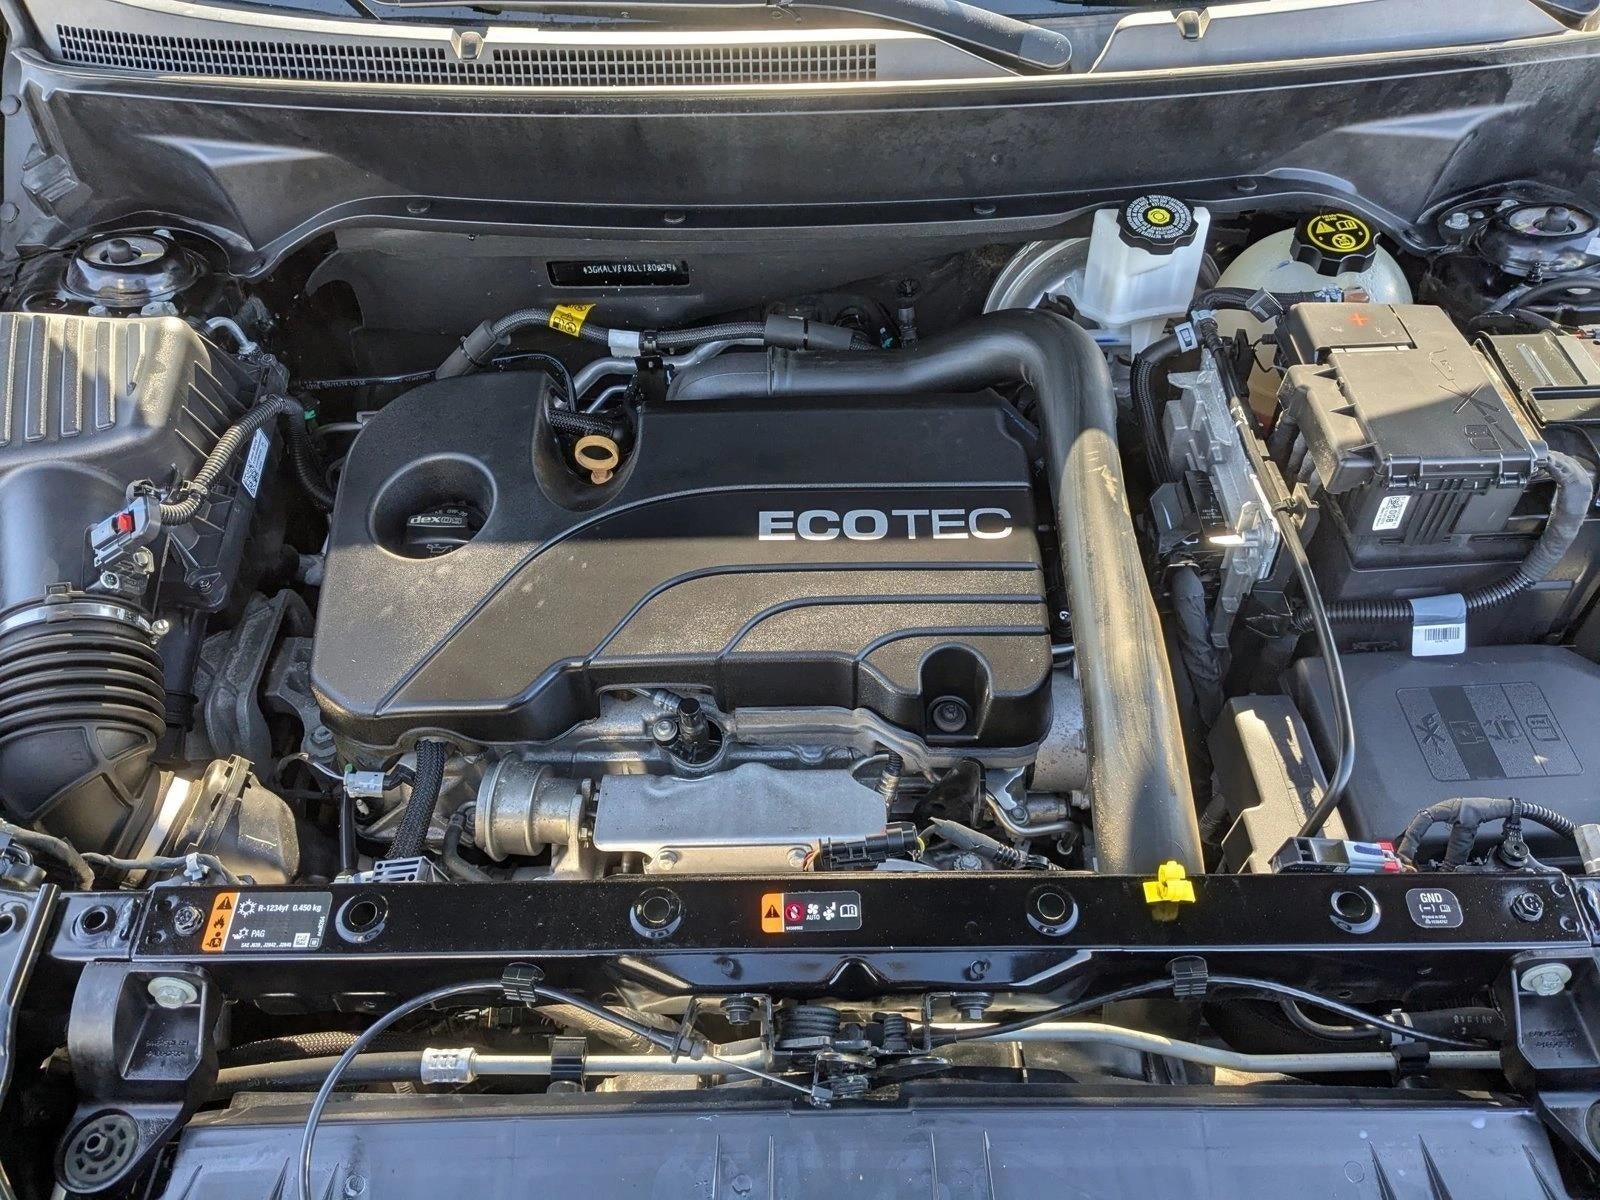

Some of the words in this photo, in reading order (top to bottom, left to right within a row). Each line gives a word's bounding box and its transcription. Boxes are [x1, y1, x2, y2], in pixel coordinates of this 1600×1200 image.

[410, 515, 463, 525] dexos
[758, 508, 1013, 540] ECOTEC
[1420, 893, 1442, 902] GND
[257, 904, 289, 913] R-1234yf
[292, 904, 312, 912] 0.450
[312, 904, 322, 913] kg
[251, 930, 266, 938] PAG
